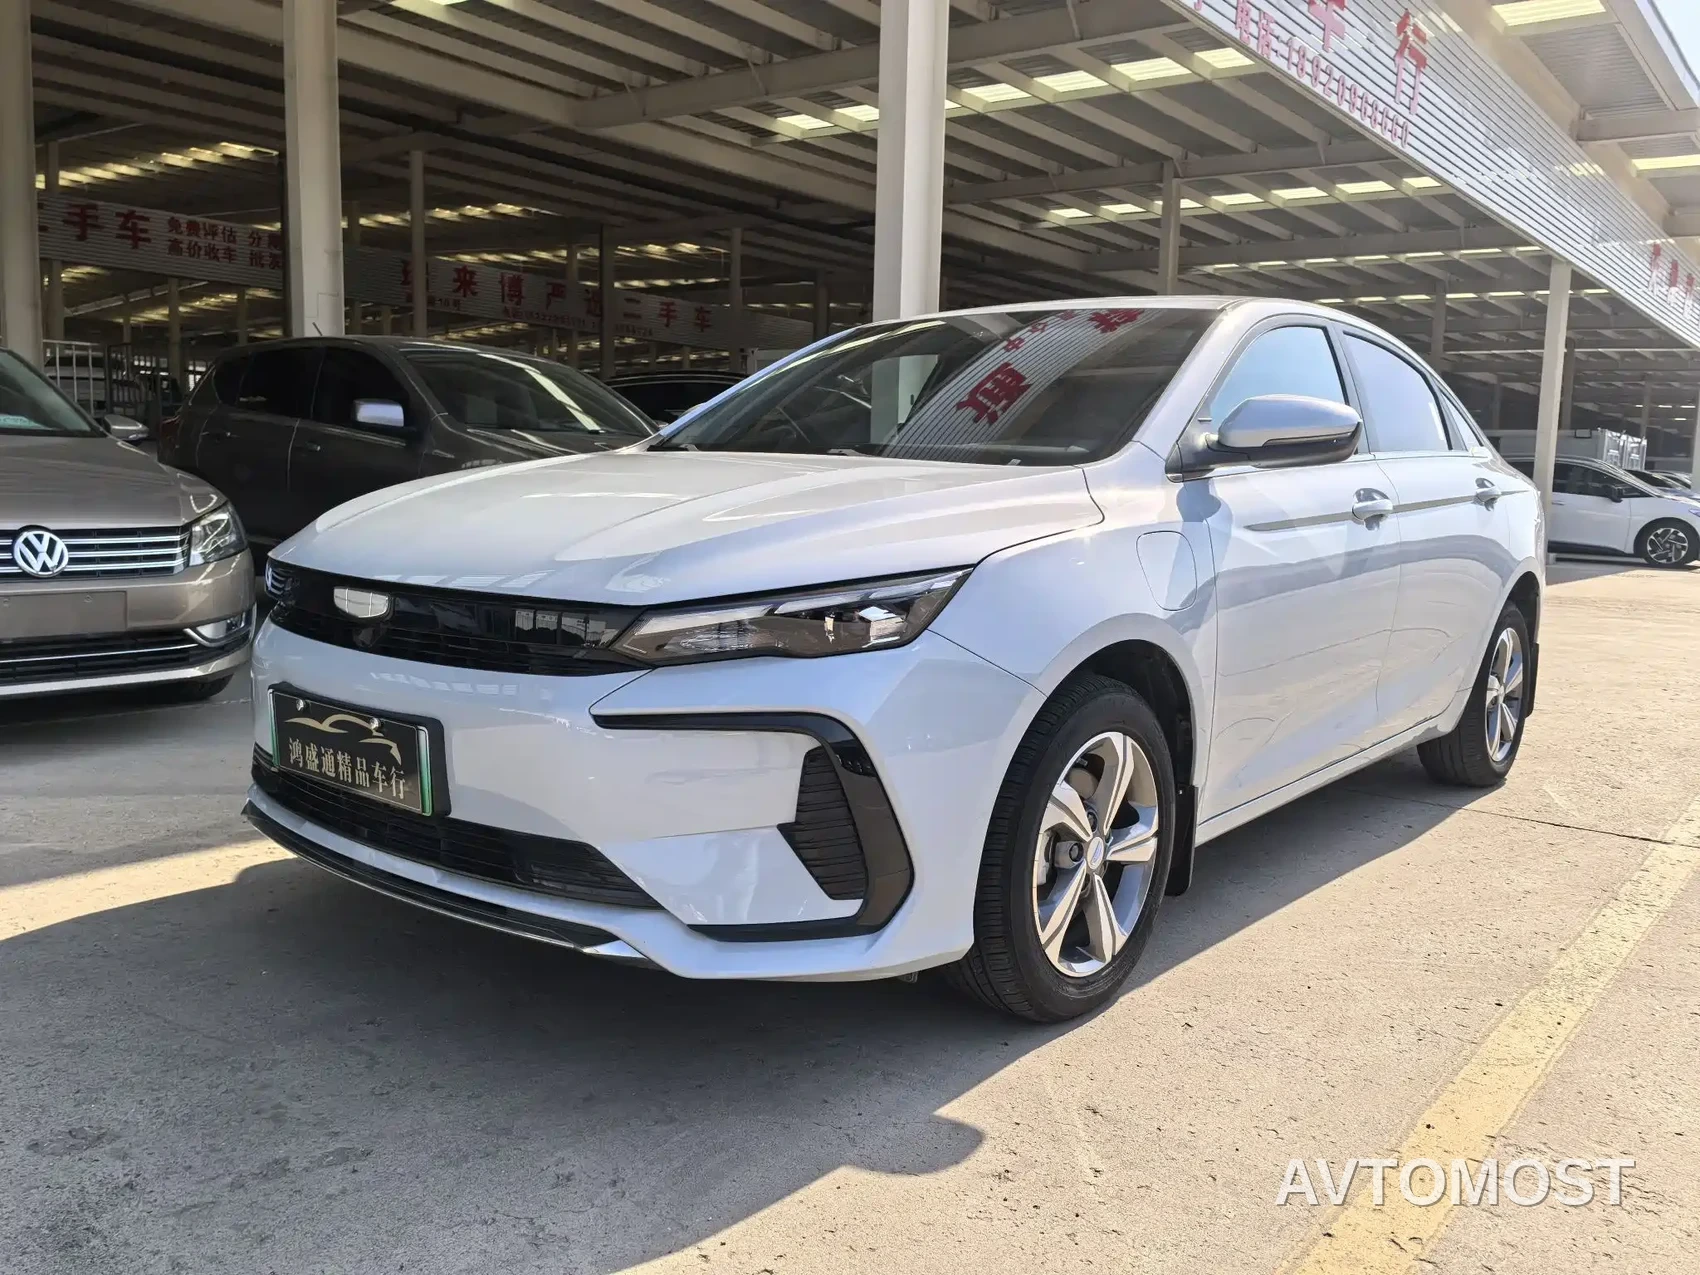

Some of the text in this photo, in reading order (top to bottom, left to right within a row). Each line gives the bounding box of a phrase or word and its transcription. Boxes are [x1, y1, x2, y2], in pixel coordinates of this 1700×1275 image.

[38, 202, 152, 250] 手车
[289, 736, 406, 800] 鸿盛通精品车行
